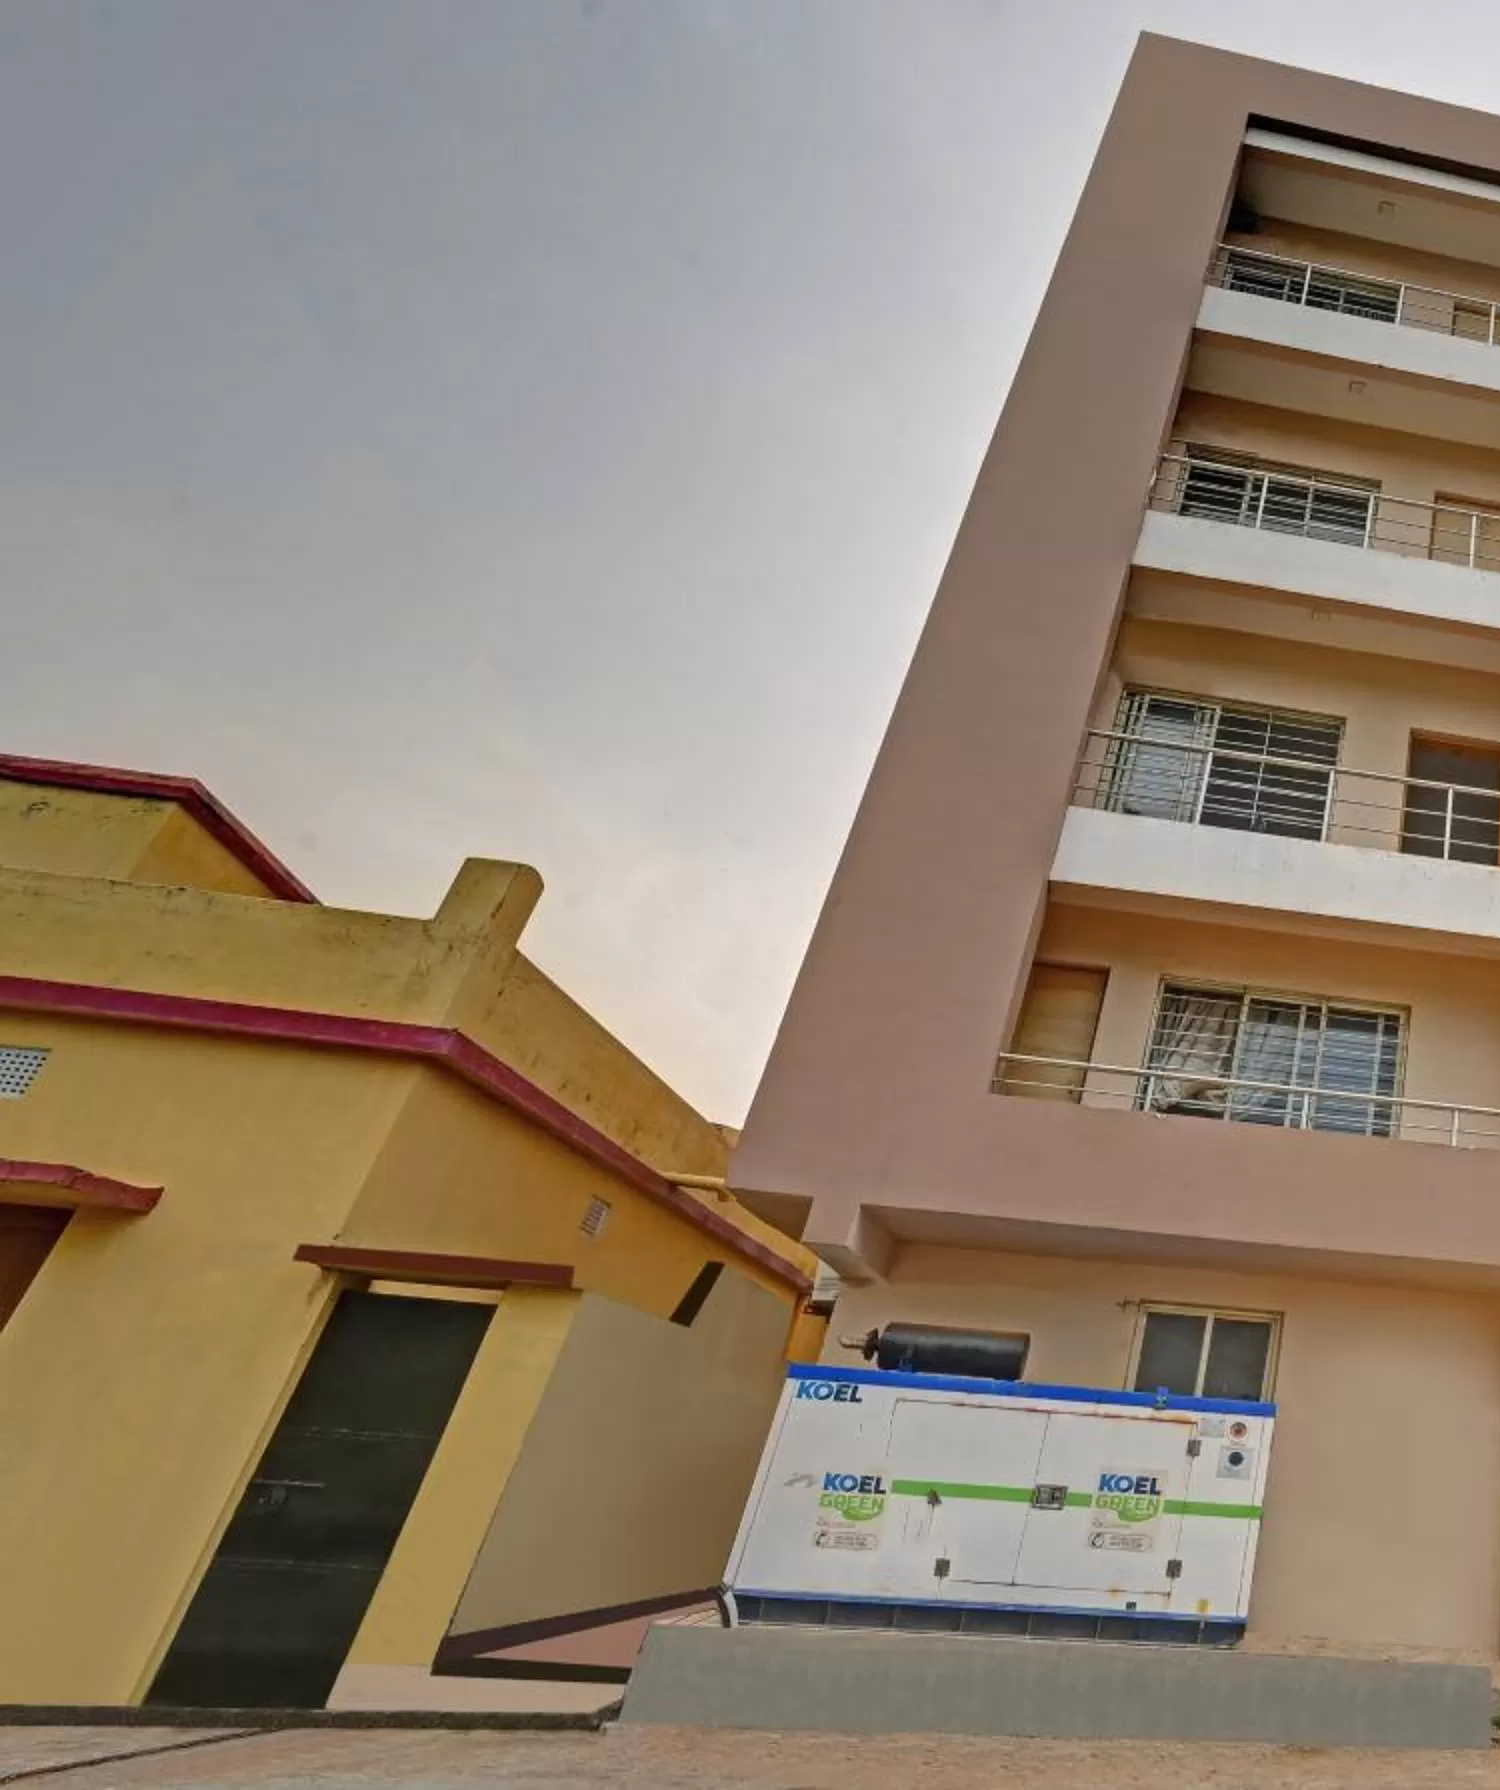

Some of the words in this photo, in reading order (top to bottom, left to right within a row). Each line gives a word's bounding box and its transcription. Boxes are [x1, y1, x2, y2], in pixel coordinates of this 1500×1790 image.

[797, 1381, 862, 1402] KOEL
[823, 1472, 886, 1494] KOEL
[1098, 1473, 1162, 1495] KOEL
[819, 1493, 885, 1513] GREEN
[1095, 1494, 1161, 1514] GREEN
